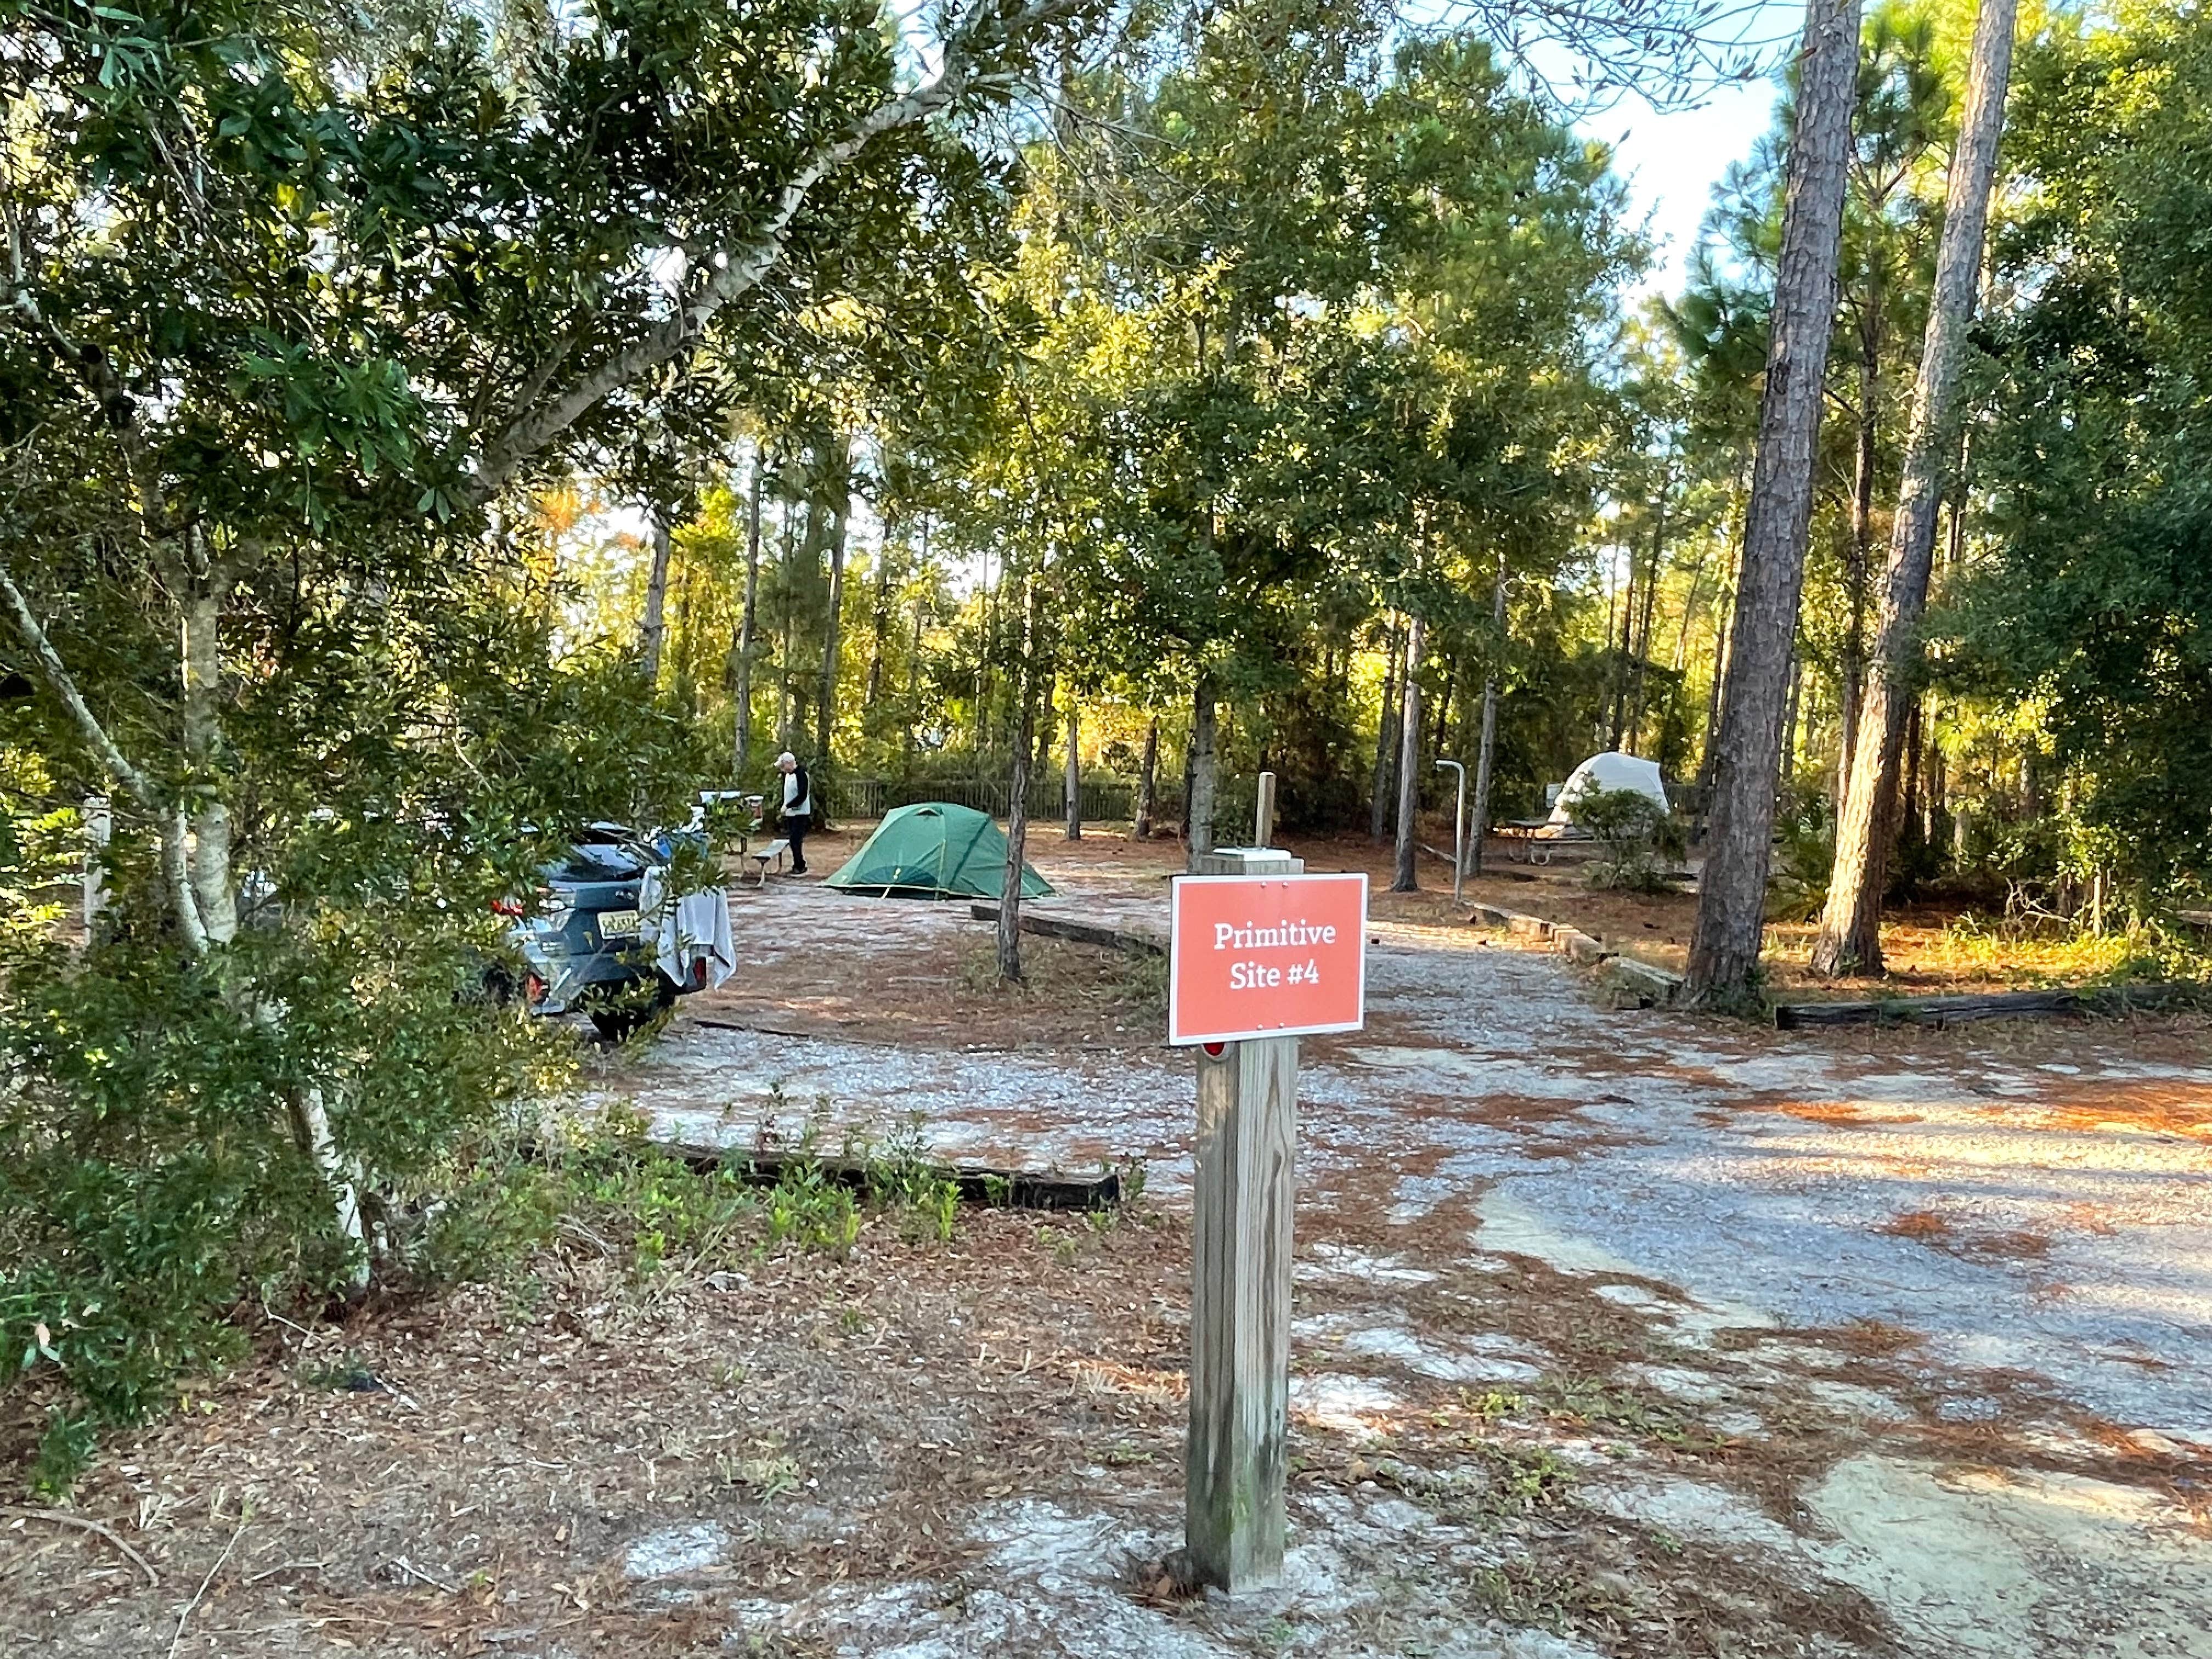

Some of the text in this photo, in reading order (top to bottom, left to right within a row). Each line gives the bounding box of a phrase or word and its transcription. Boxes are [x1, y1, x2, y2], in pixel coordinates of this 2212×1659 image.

[1214, 918, 1336, 950] Primitive
[1230, 958, 1319, 989] Site #4
